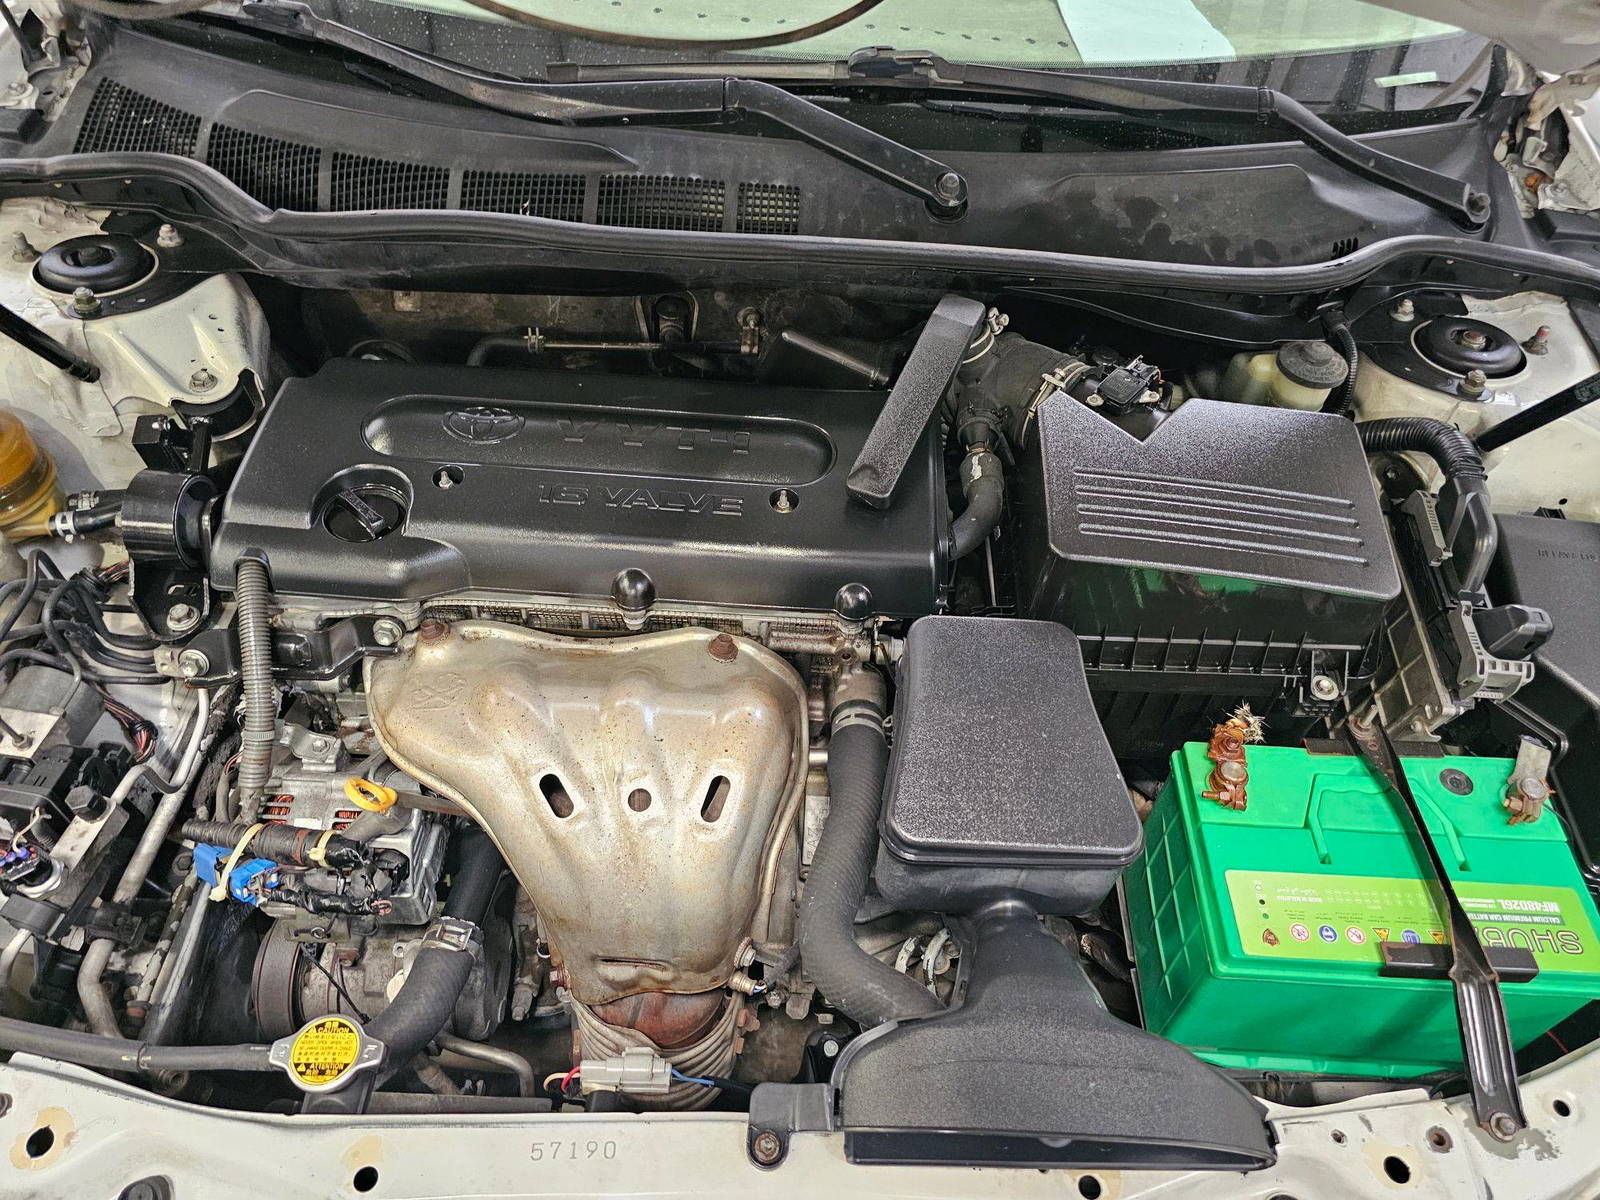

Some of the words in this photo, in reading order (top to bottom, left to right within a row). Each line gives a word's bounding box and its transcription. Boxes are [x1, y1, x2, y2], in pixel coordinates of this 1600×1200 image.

[537, 482, 590, 506] 16
[600, 486, 746, 517] VALVE
[1473, 926, 1584, 954] SHUB
[318, 1026, 350, 1034] CAUTION
[529, 1140, 617, 1162] 57190
